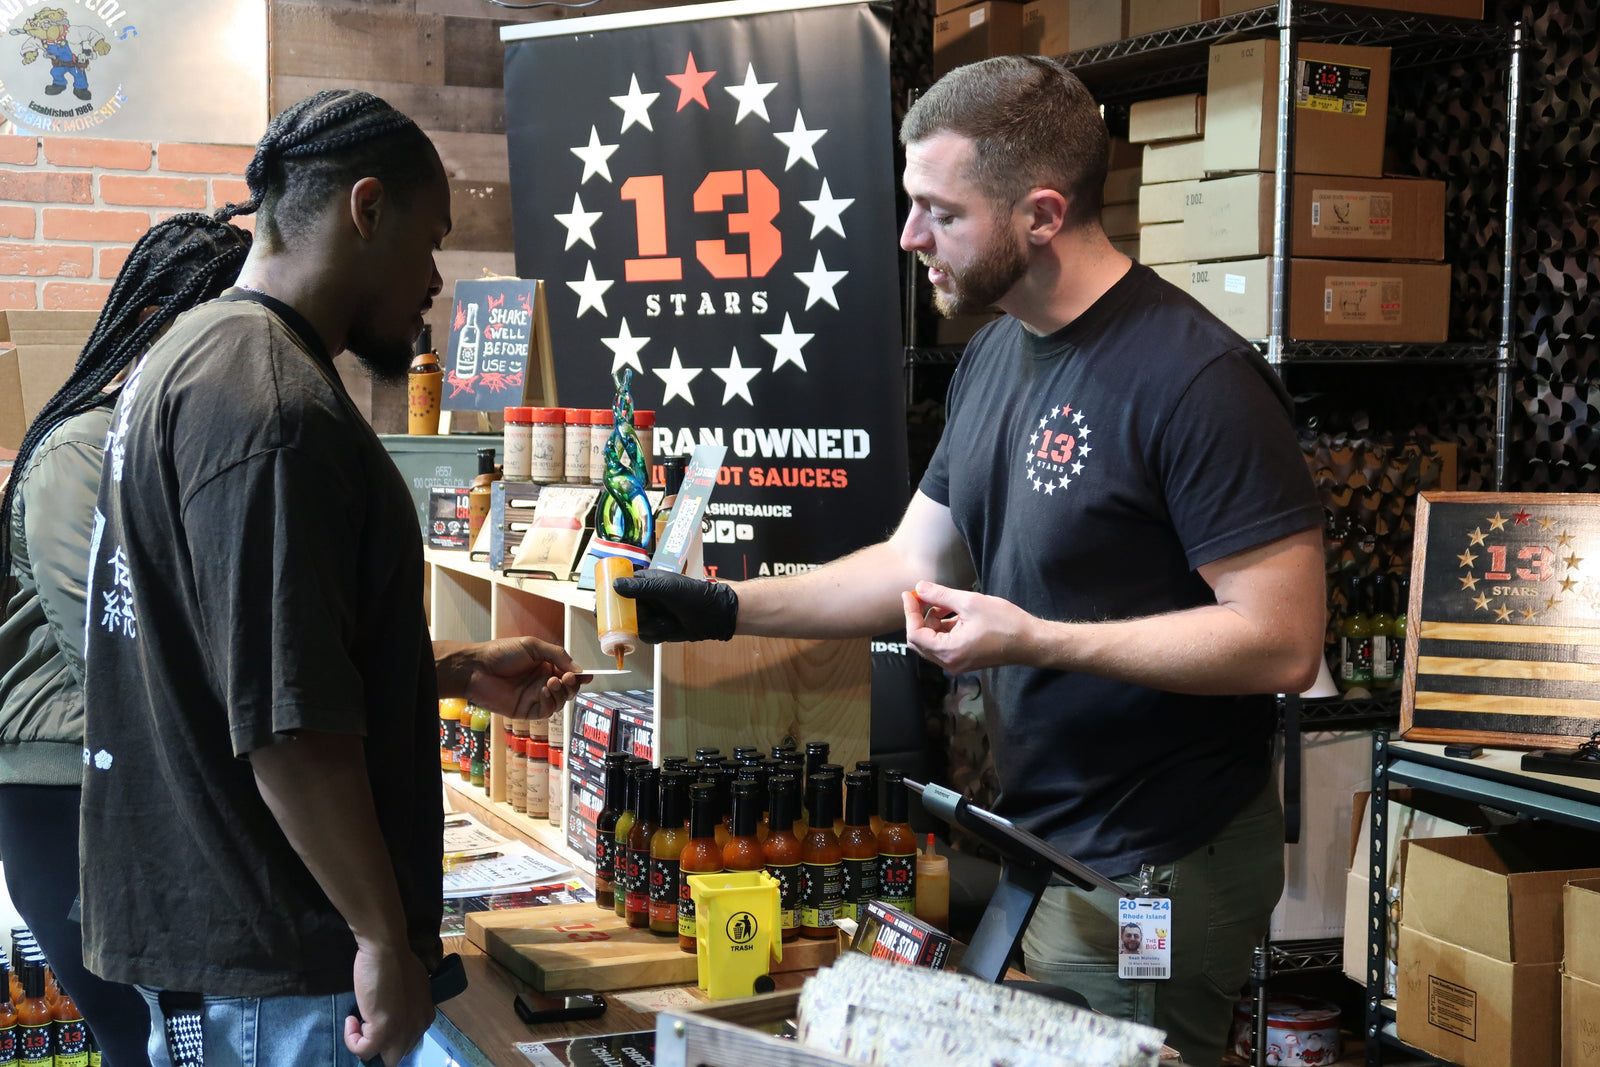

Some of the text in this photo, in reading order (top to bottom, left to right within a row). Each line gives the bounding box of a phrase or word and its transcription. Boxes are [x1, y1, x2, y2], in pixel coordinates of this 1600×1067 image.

[1321, 73, 1337, 84] 13
[28, 100, 94, 118] Established 1988
[63, 109, 104, 132] MORE
[1186, 195, 1190, 206] 2
[620, 169, 782, 282] 13
[1192, 273, 1196, 283] 2
[646, 291, 769, 317] STARS
[489, 308, 529, 326] SHAKE
[490, 327, 526, 340] WELL
[483, 341, 529, 357] BEFORE
[482, 359, 507, 372] USE
[733, 428, 870, 460] OWNED
[1036, 429, 1076, 464] 13
[1037, 461, 1065, 473] STARS
[750, 466, 848, 488] SAUCES
[457, 496, 469, 508] LO
[1485, 545, 1554, 581] 13
[1492, 586, 1540, 597] STARS
[886, 869, 907, 882] 13
[1119, 901, 1170, 911] 20 24
[876, 924, 901, 952] LONE
[896, 935, 920, 963] STAR
[1158, 938, 1166, 950] E
[27, 1036, 45, 1047] 13
[64, 1031, 82, 1043] 13
